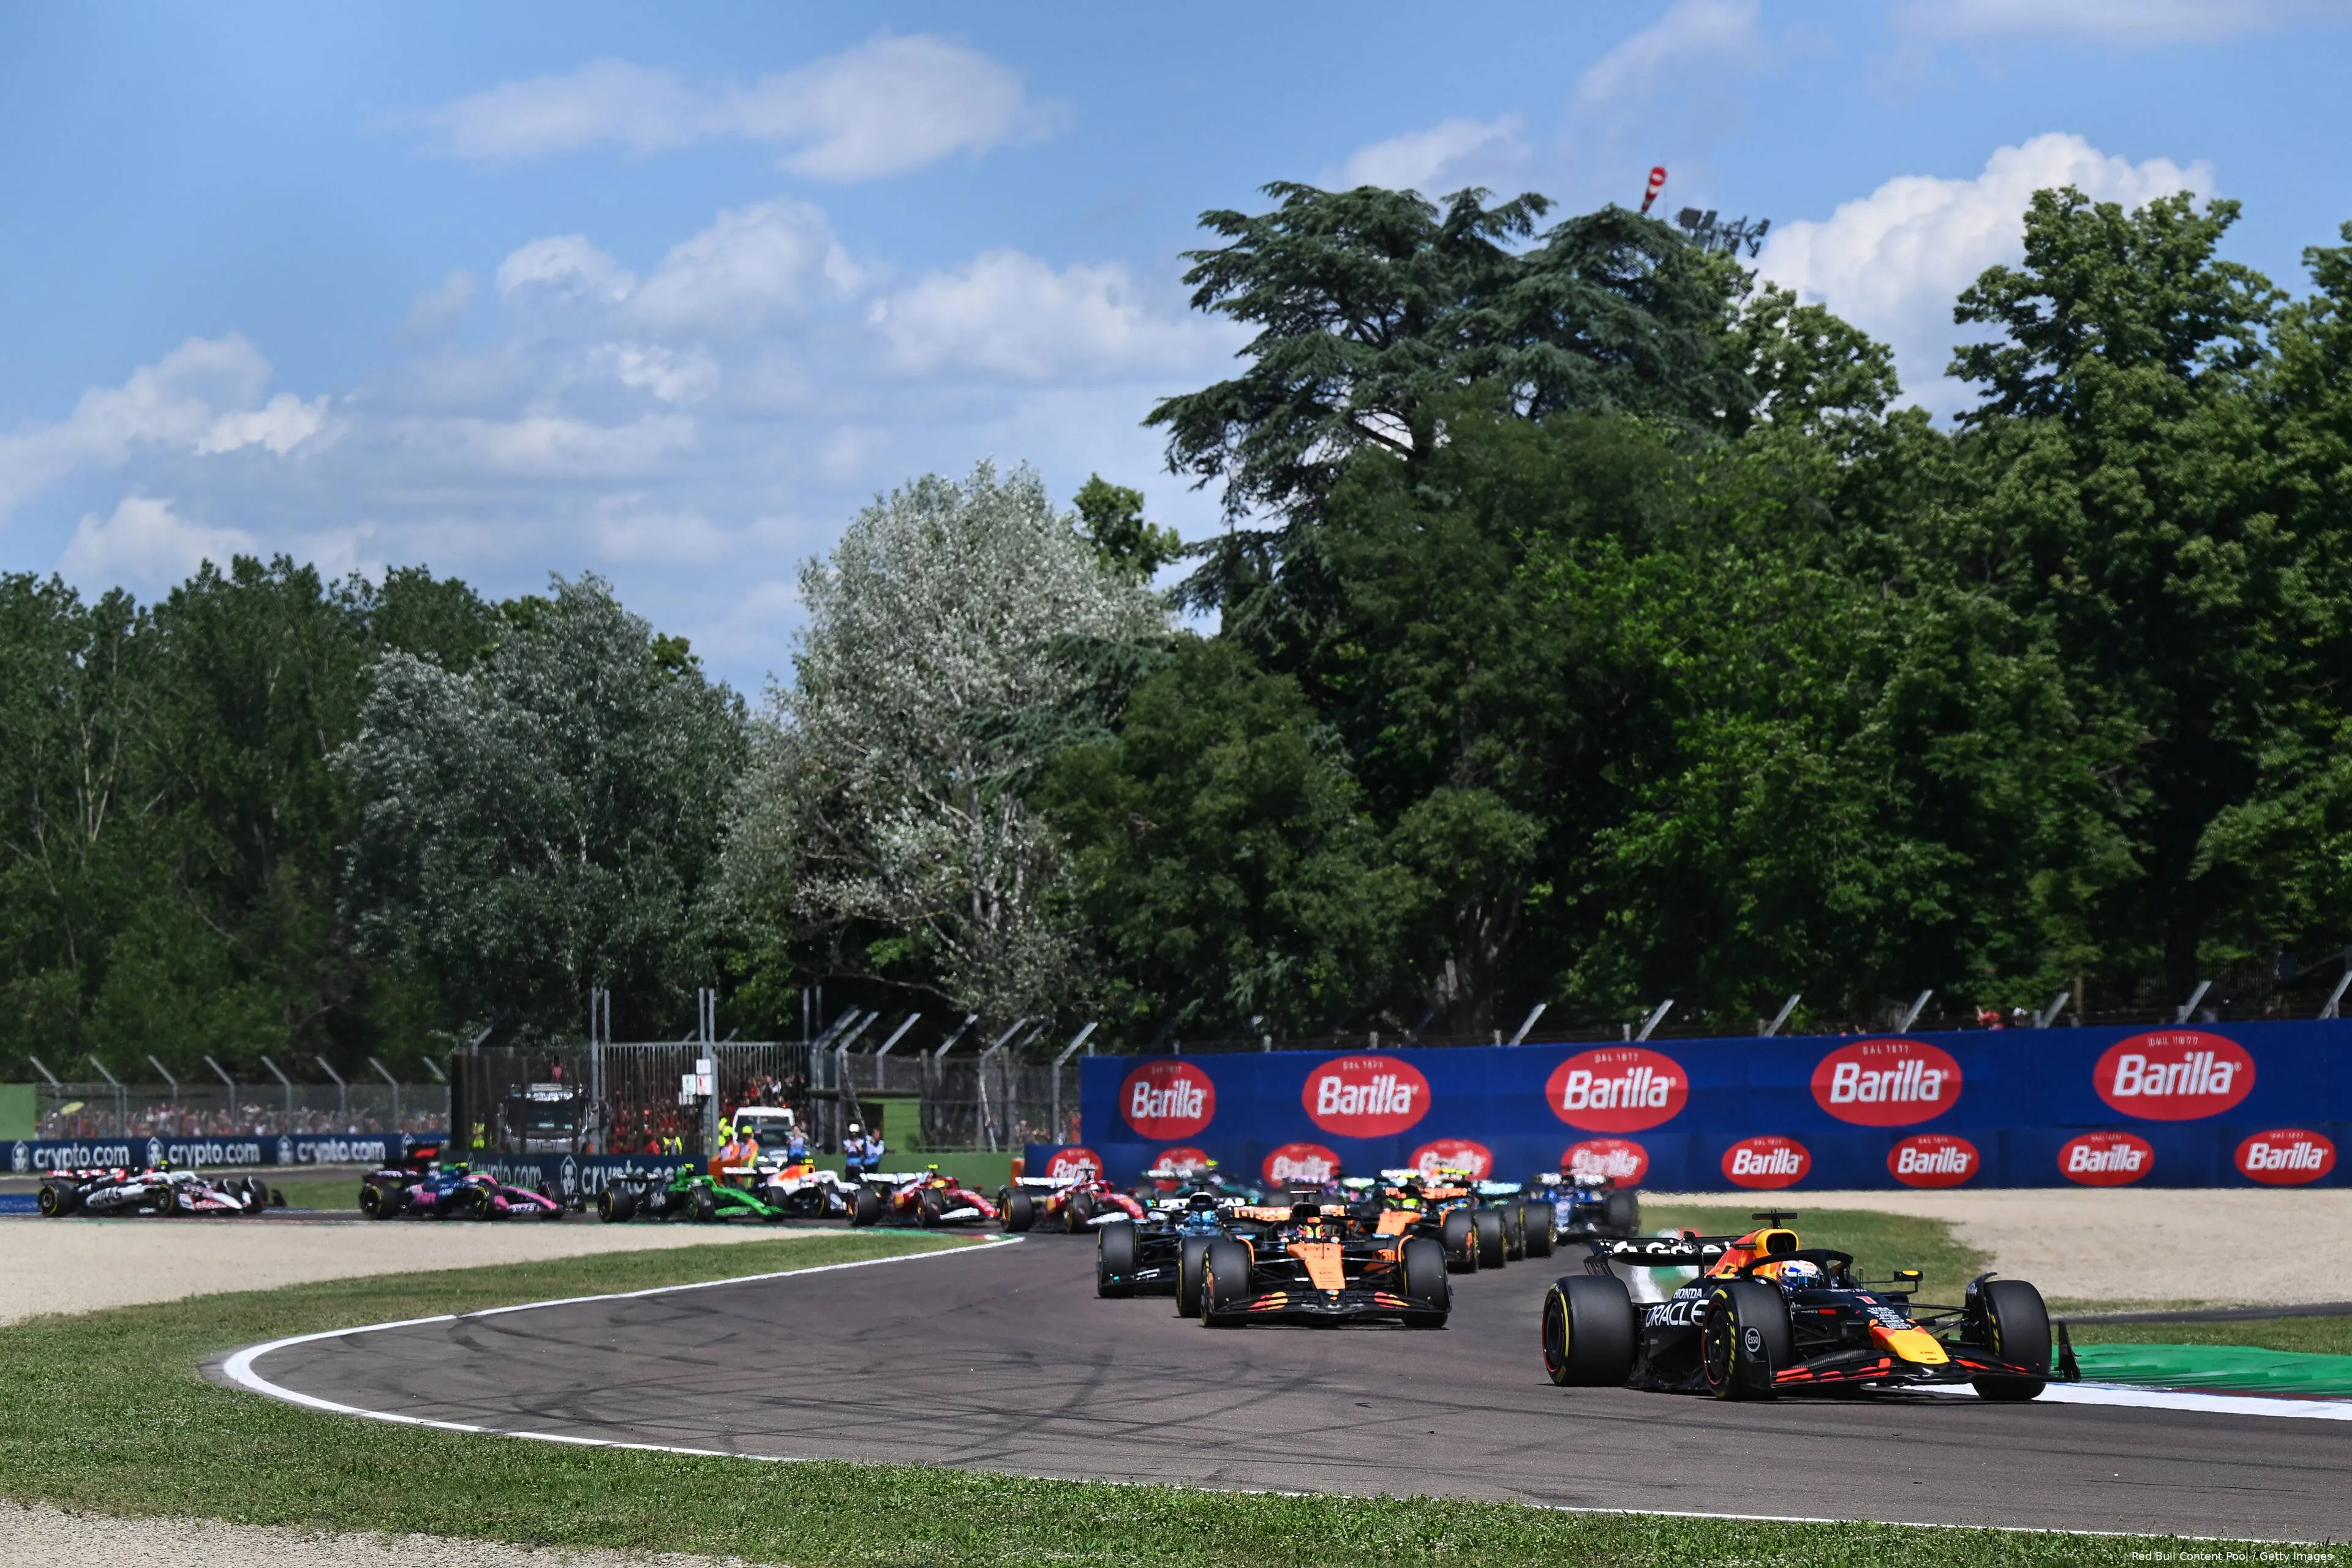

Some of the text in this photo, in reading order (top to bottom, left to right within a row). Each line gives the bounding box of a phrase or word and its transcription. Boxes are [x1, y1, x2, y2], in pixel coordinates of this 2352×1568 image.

[1830, 1059, 1942, 1103] Barilla
[2113, 1050, 2234, 1096] Barilla
[1131, 1079, 1203, 1118] Barilla
[1317, 1074, 1412, 1115] Barilla
[1563, 1066, 1670, 1110] Barilla
[34, 1142, 130, 1170] crypto.com
[168, 1140, 260, 1168] crypto.com
[1732, 1148, 1800, 1174] Barilla
[1898, 1146, 1967, 1174] Barilla
[2246, 1142, 2323, 1170] Barilla
[1673, 1288, 1702, 1299] HONDA
[1855, 1295, 1877, 1304] 1
[1645, 1300, 1709, 1328] ORACLE
[1747, 1335, 1758, 1344] Esso
